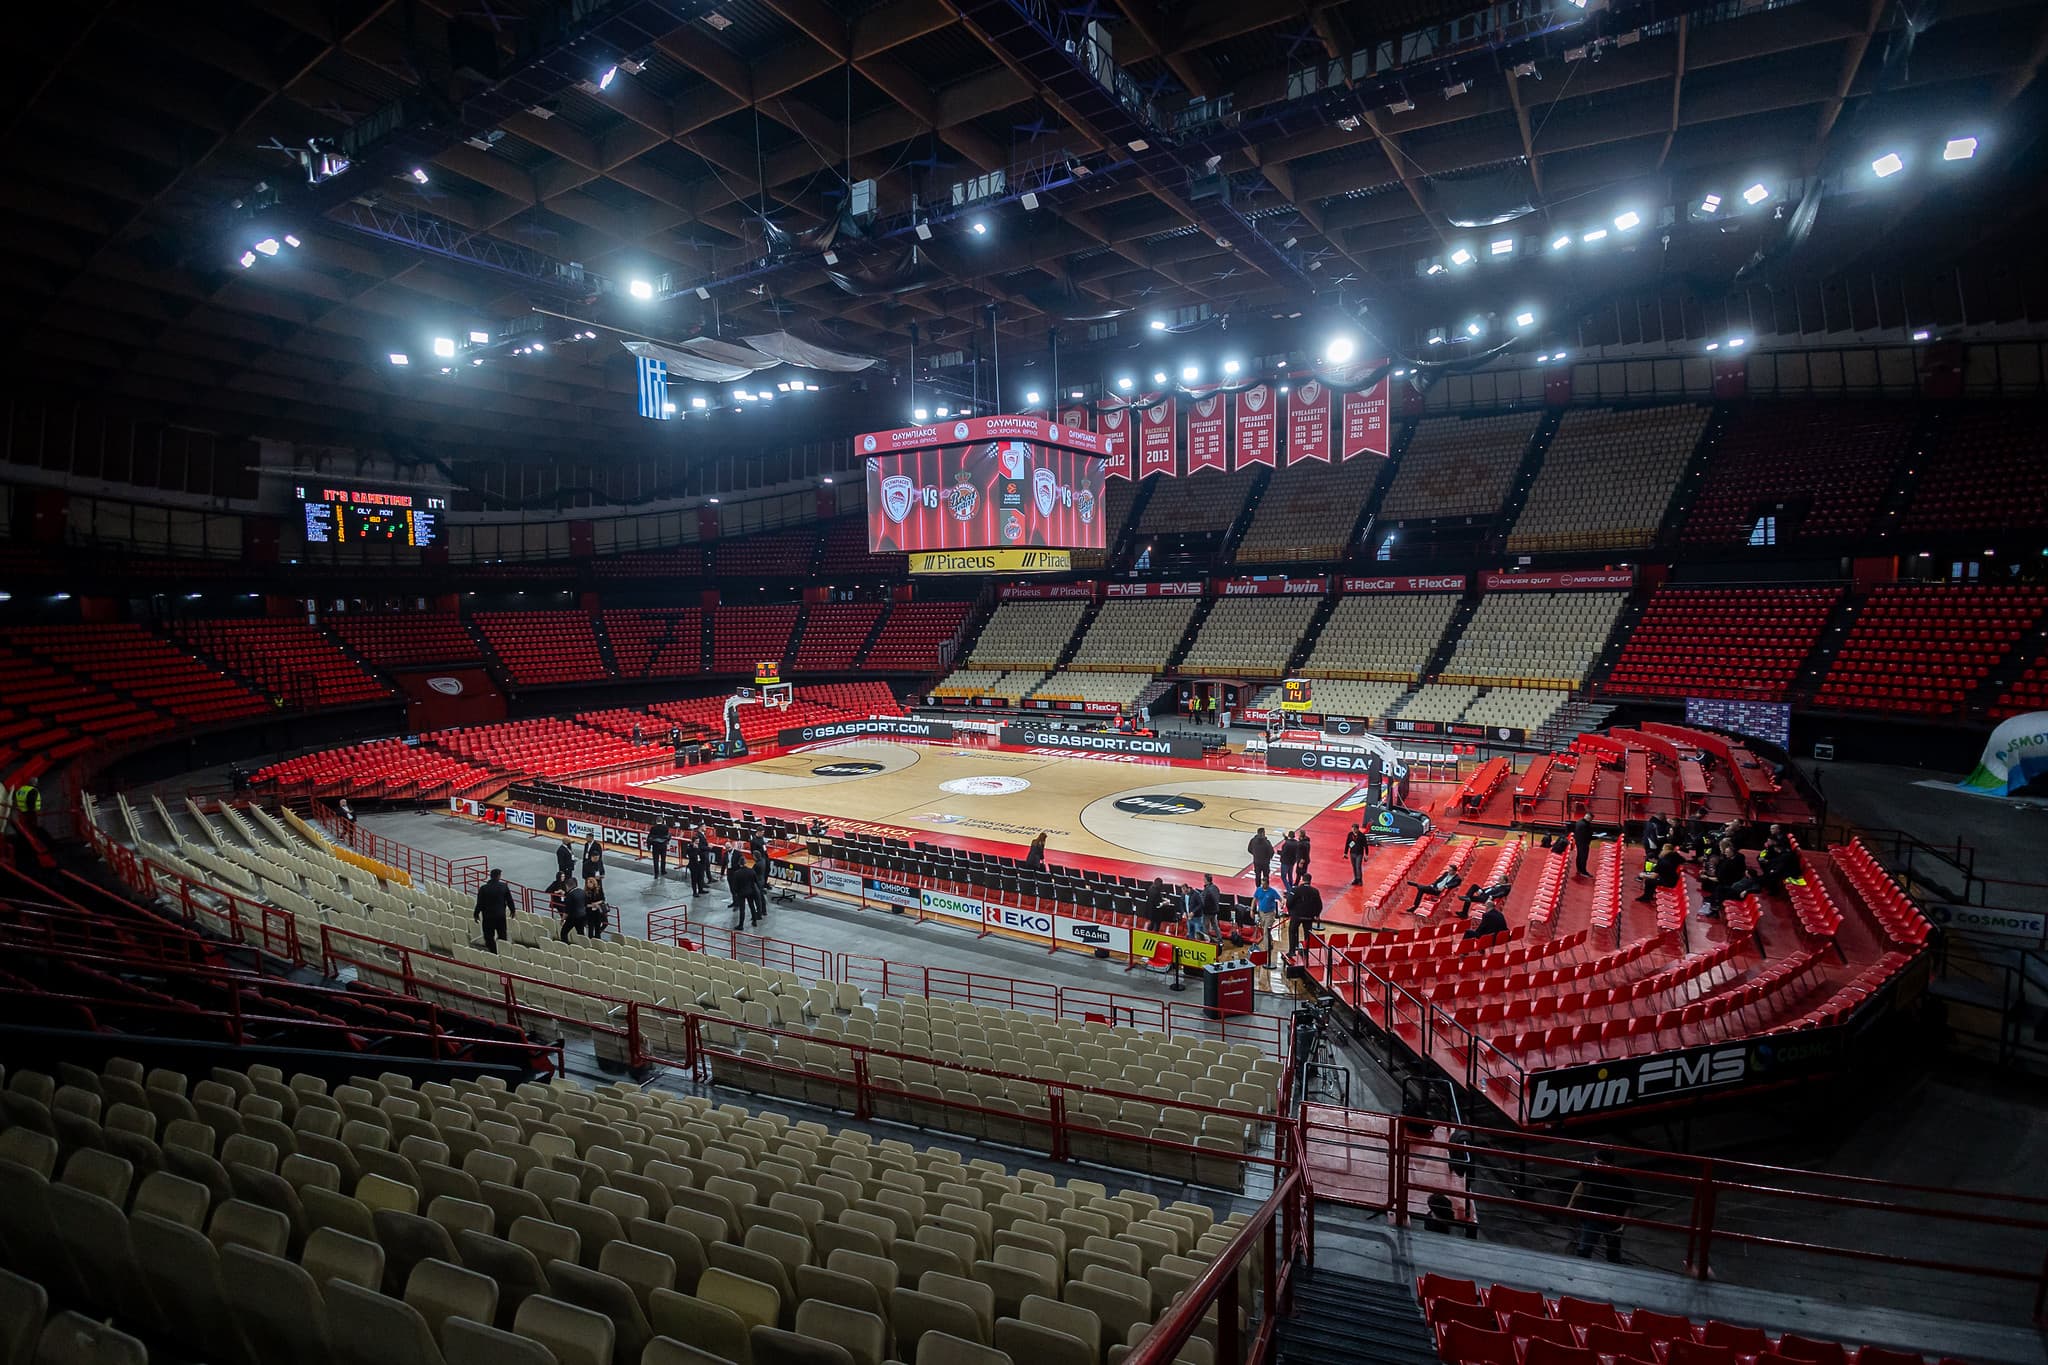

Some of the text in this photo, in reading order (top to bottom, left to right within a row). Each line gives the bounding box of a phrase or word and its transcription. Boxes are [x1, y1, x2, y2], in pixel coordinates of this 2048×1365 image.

[986, 418, 1038, 429] ΟΛΥΜΠΙΑΚΟΣ
[892, 428, 936, 441] ΟΛΥΜΠΙΑΚΟΣ
[1147, 450, 1169, 463] 2013
[324, 490, 348, 502] IT'S
[922, 488, 938, 508] VS
[1062, 486, 1071, 507] VS
[938, 554, 995, 569] Piraeus
[1108, 584, 1147, 595] FMS
[1160, 583, 1201, 595] FMS
[1225, 582, 1258, 594] bwin
[1284, 580, 1319, 593] bwin
[1355, 580, 1395, 590] FlexCar
[1418, 578, 1462, 588] FlexCar
[1012, 588, 1040, 596] Piraeus
[1061, 588, 1090, 596] Piraeus
[1290, 690, 1302, 700] 14
[815, 722, 930, 738] GSASPORT.COM
[1037, 733, 1171, 754] GSASPORT.COM
[1028, 748, 1141, 762] PIRAEUS
[1120, 797, 1196, 814] bwin
[506, 809, 534, 825] FMS
[1371, 825, 1400, 833] COSMOTE
[604, 828, 639, 848] AXE
[881, 883, 910, 894] ΟΜΗΡΟΣ
[932, 897, 982, 915] COSMOTE
[1005, 912, 1050, 932] EKO
[1957, 913, 2040, 931] COSMOTE
[1074, 928, 1109, 942] ΔΕΔΔΗΕ
[1175, 945, 1207, 962] aeus
[1530, 1048, 1746, 1118] bwin FMS
